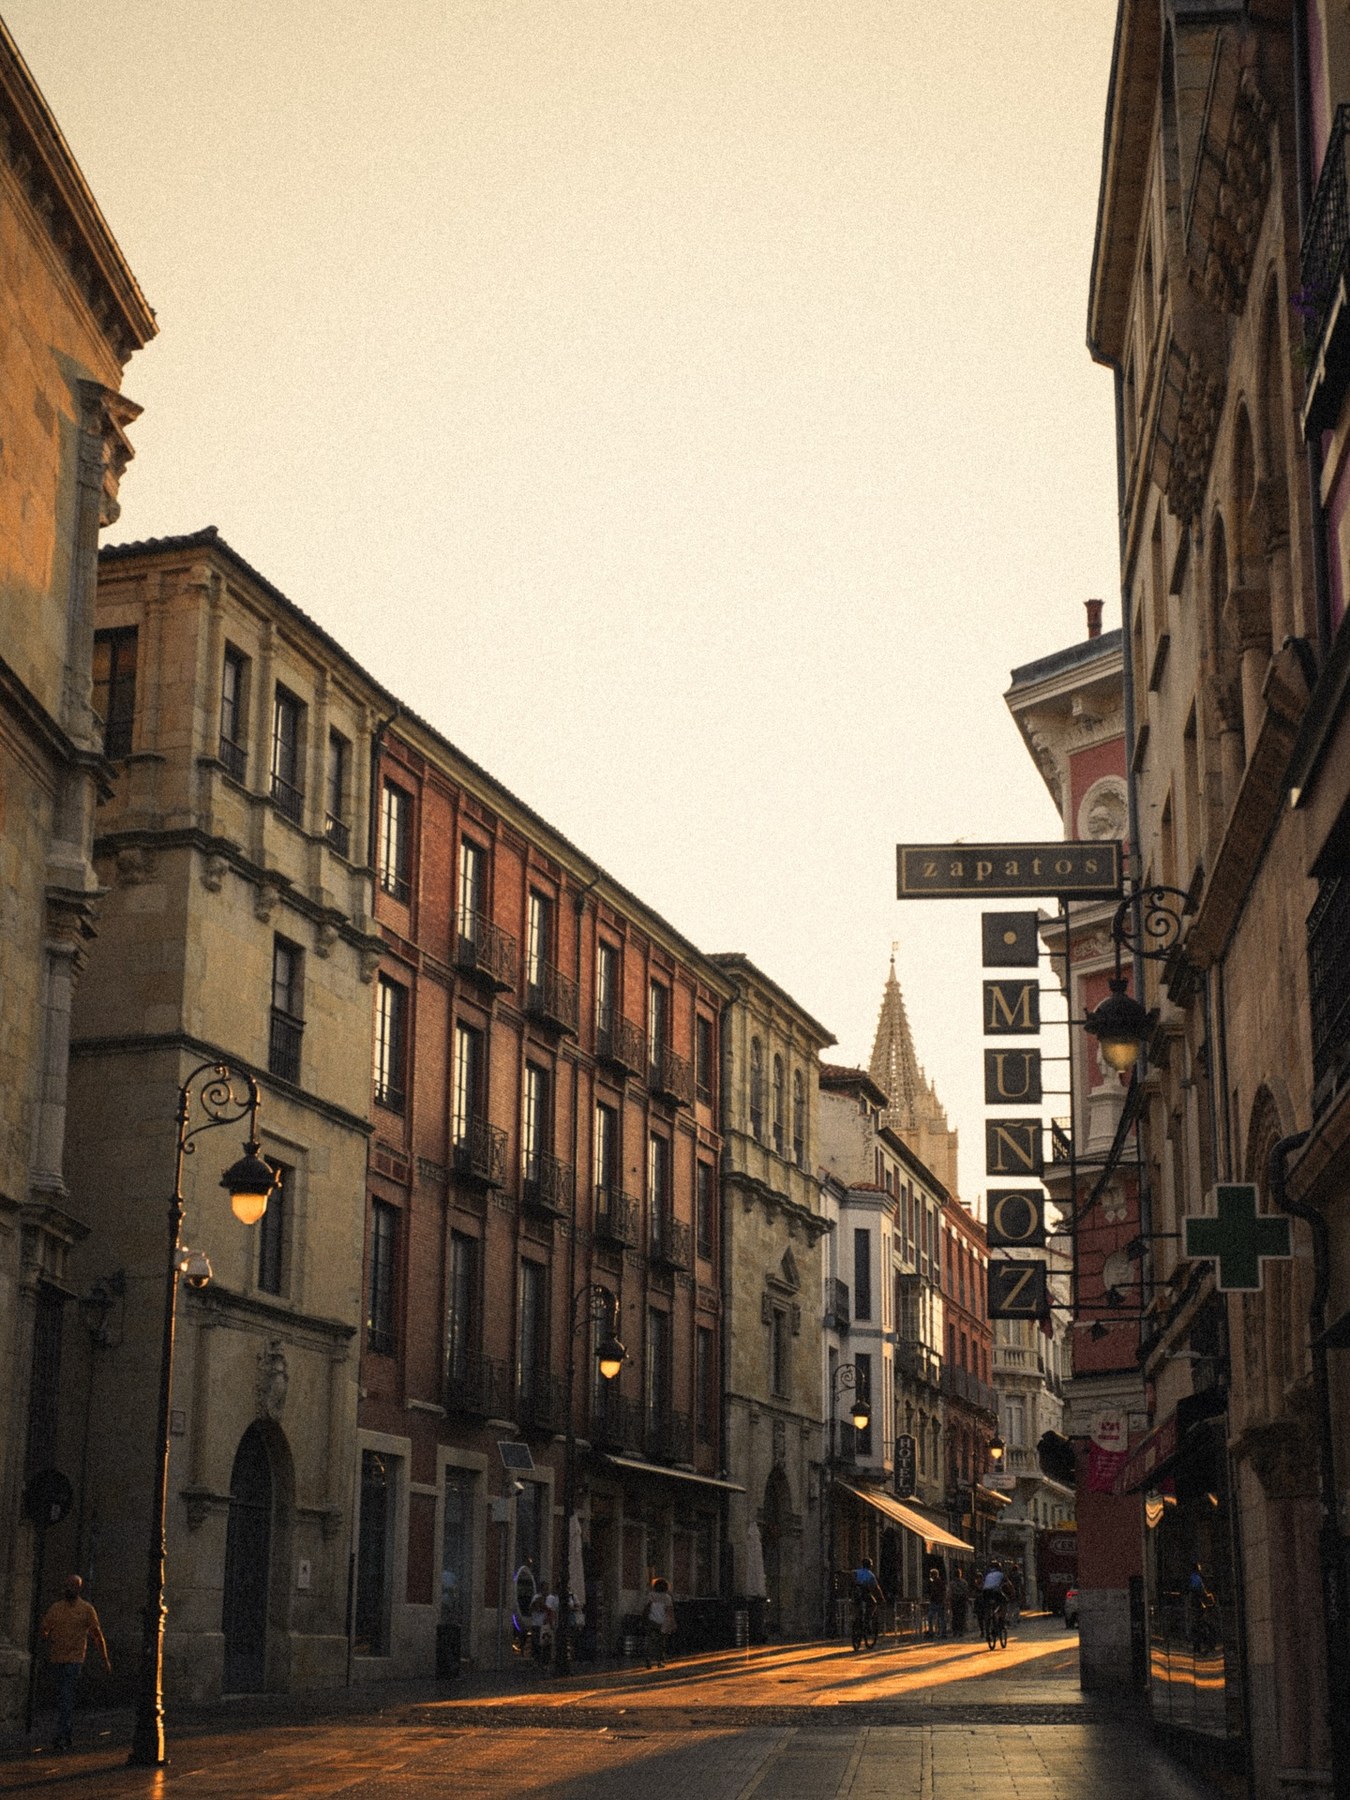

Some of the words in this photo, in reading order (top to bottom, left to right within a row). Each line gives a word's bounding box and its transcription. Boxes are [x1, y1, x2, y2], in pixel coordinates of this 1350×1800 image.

[922, 857, 1098, 881] zapatos
[987, 985, 1040, 1312] MUÑOZ
[898, 1438, 911, 1487] HOTEL
